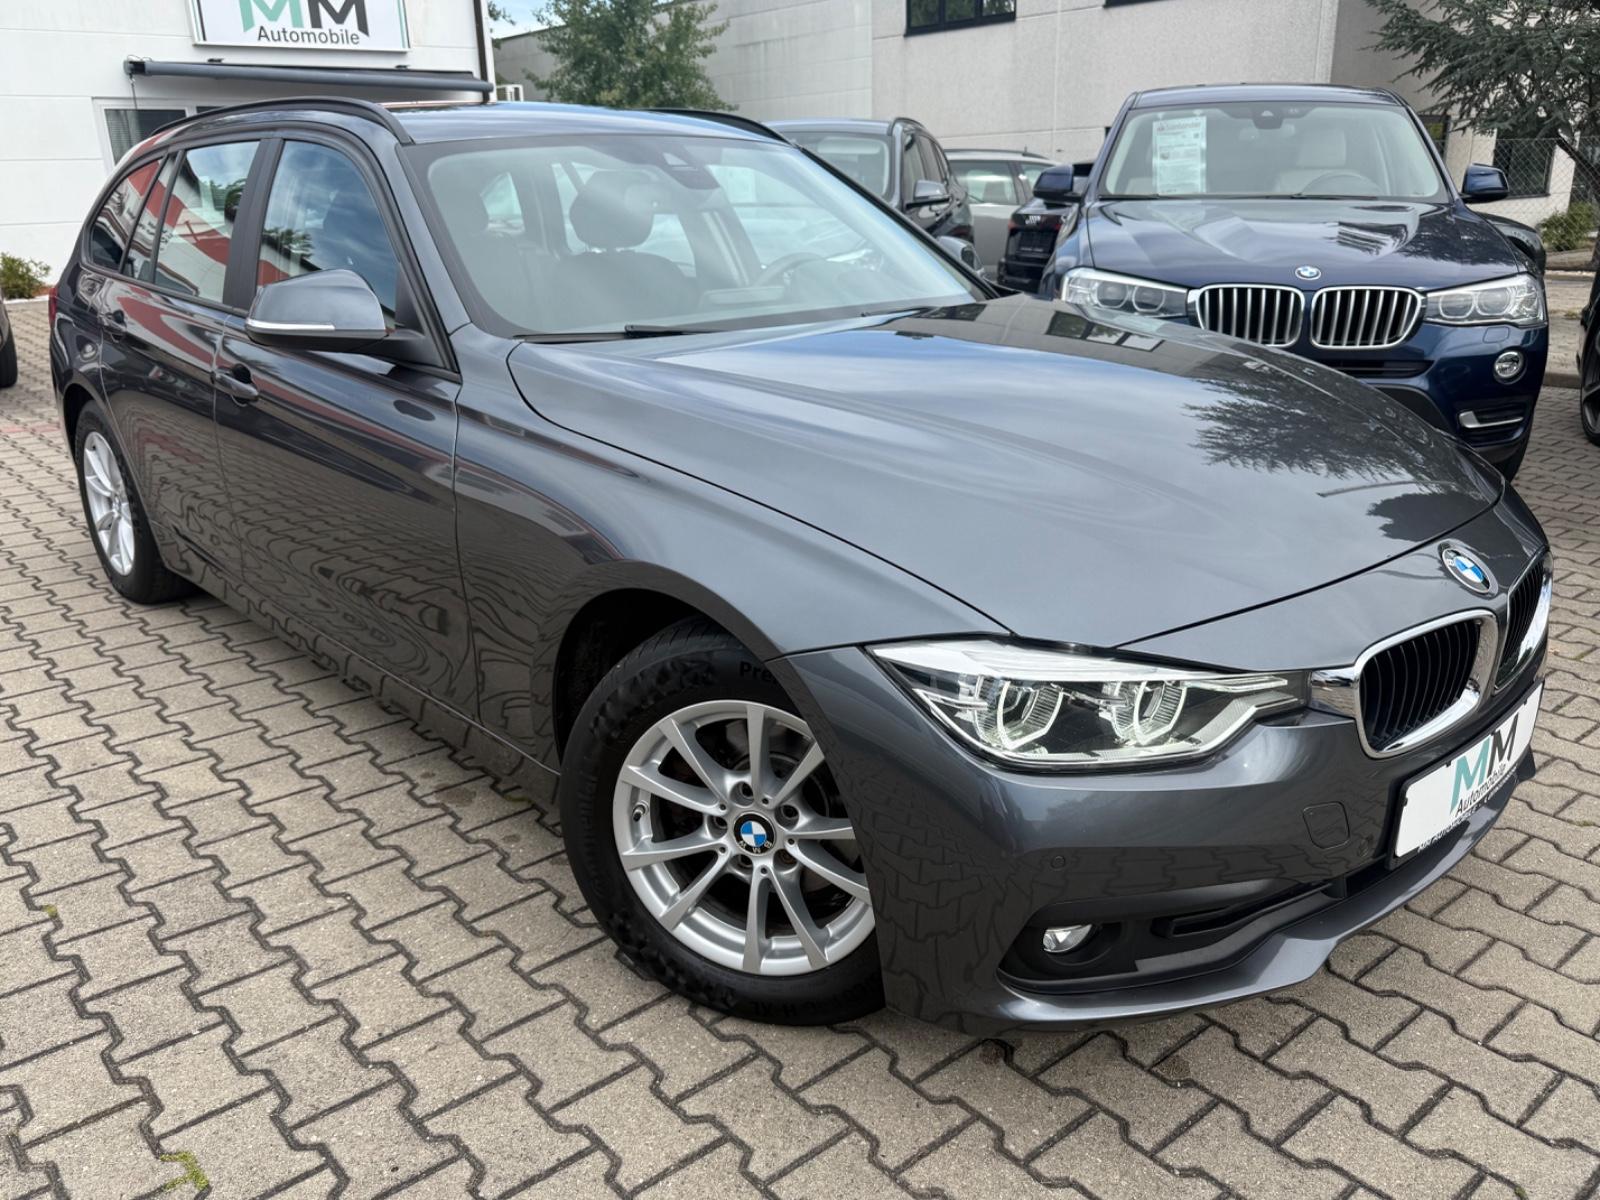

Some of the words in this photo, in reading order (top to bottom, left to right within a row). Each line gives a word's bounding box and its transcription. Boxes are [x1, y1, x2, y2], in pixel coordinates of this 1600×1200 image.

[239, 0, 369, 37] MM
[257, 26, 360, 45] Automobile
[740, 660, 776, 685] Pre
[1450, 712, 1519, 815] MM
[1455, 763, 1507, 817] Automobile
